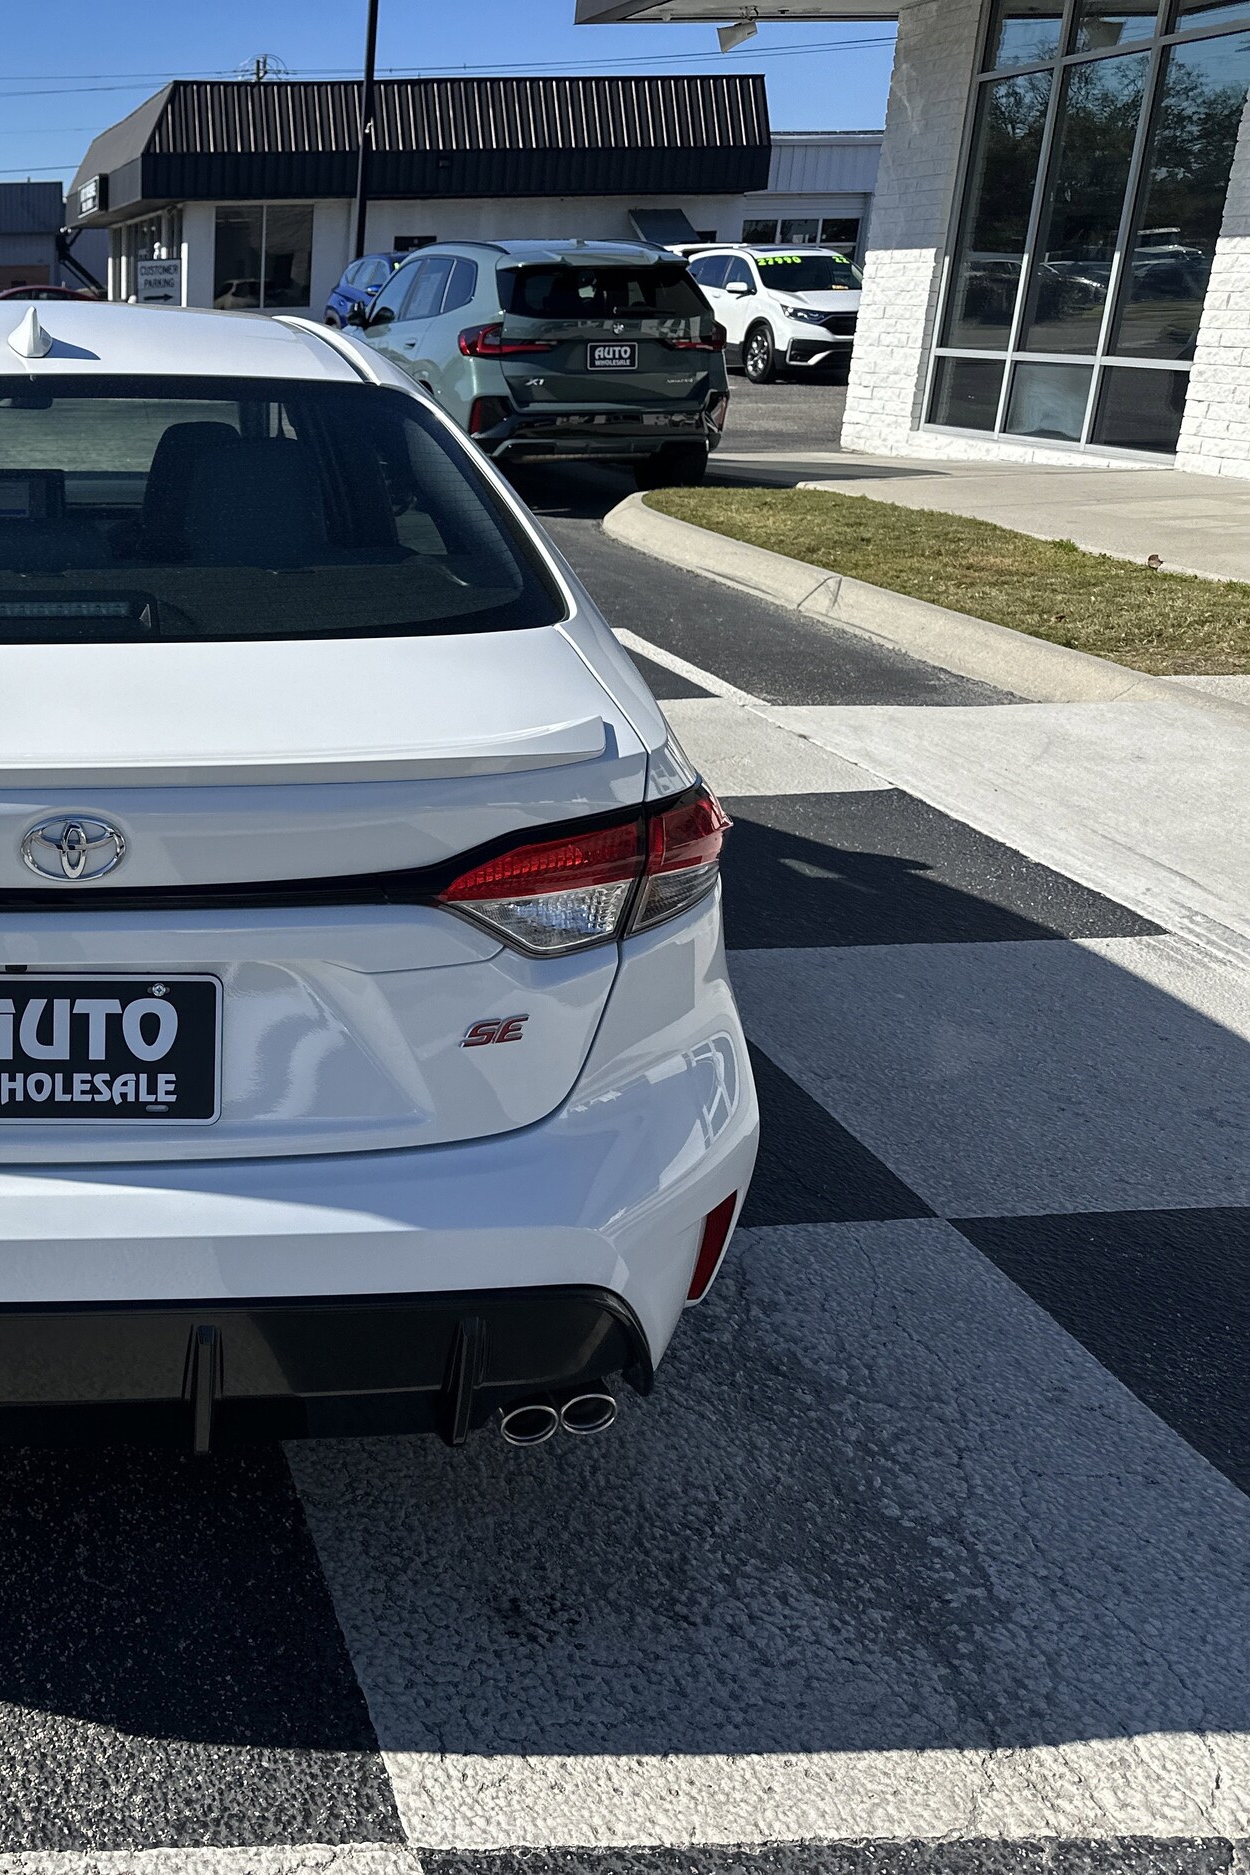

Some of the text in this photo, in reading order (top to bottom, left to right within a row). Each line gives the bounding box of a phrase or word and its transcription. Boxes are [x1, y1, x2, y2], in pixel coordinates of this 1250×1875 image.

[757, 256, 802, 266] 27990
[832, 256, 850, 264] 22
[140, 264, 179, 276] CUSTOMER
[144, 277, 175, 288] PARKING
[594, 346, 631, 359] AUTO
[594, 359, 631, 367] WHOLESALE
[459, 1013, 530, 1048] SE
